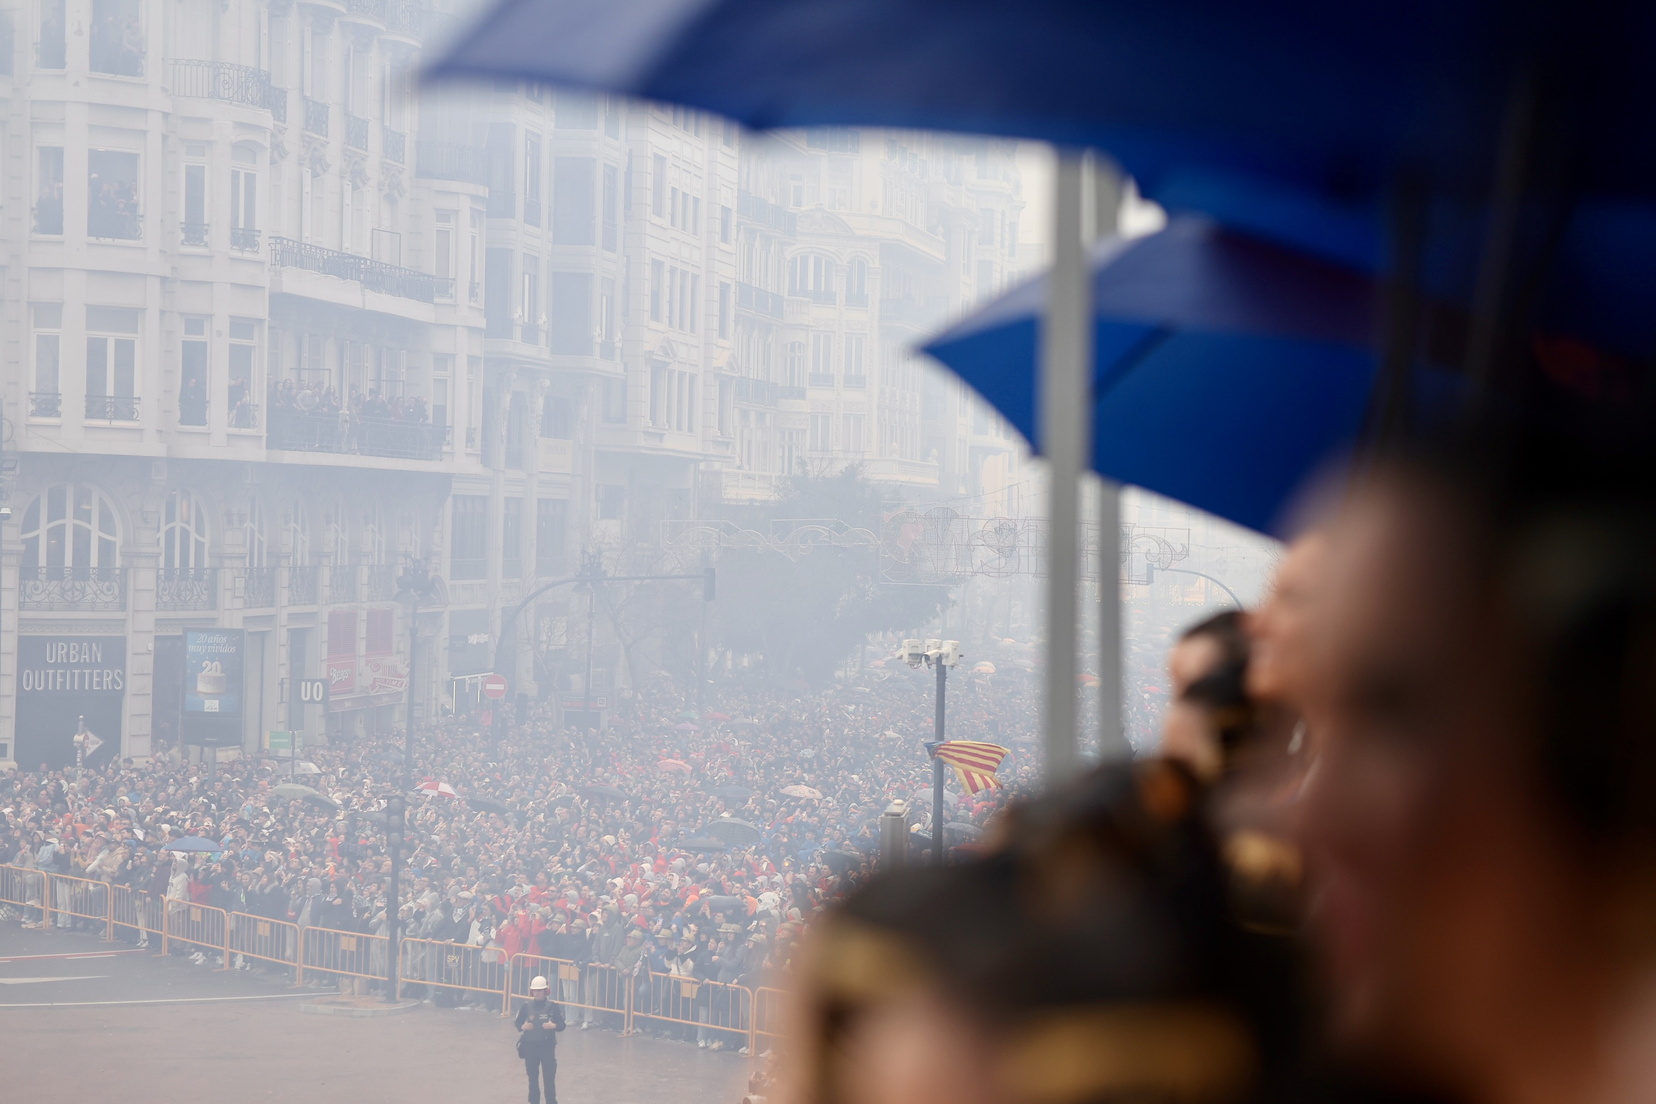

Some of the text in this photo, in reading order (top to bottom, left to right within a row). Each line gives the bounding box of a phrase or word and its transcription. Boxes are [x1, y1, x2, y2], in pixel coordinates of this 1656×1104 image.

[196, 633, 227, 644] 20 años
[46, 642, 102, 663] URBAN
[188, 643, 236, 655] muy vividos
[22, 669, 124, 691] OUTFITTERS
[301, 681, 323, 701] UO
